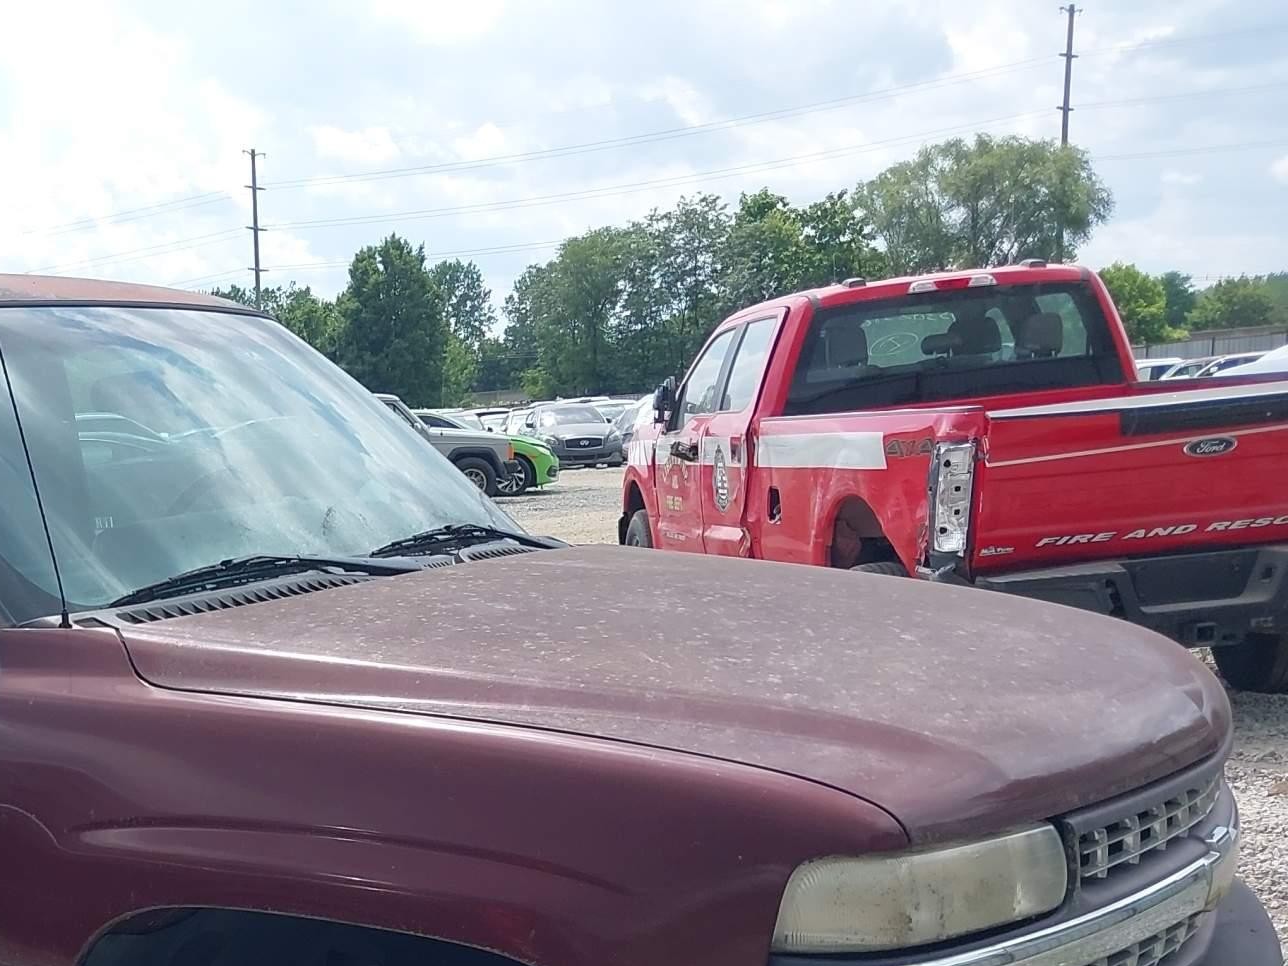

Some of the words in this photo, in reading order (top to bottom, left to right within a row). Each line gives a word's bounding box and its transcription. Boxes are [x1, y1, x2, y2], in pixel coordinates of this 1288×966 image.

[1196, 440, 1226, 453] Ford
[1035, 531, 1117, 547] FIRE
[1122, 524, 1198, 540] AND
